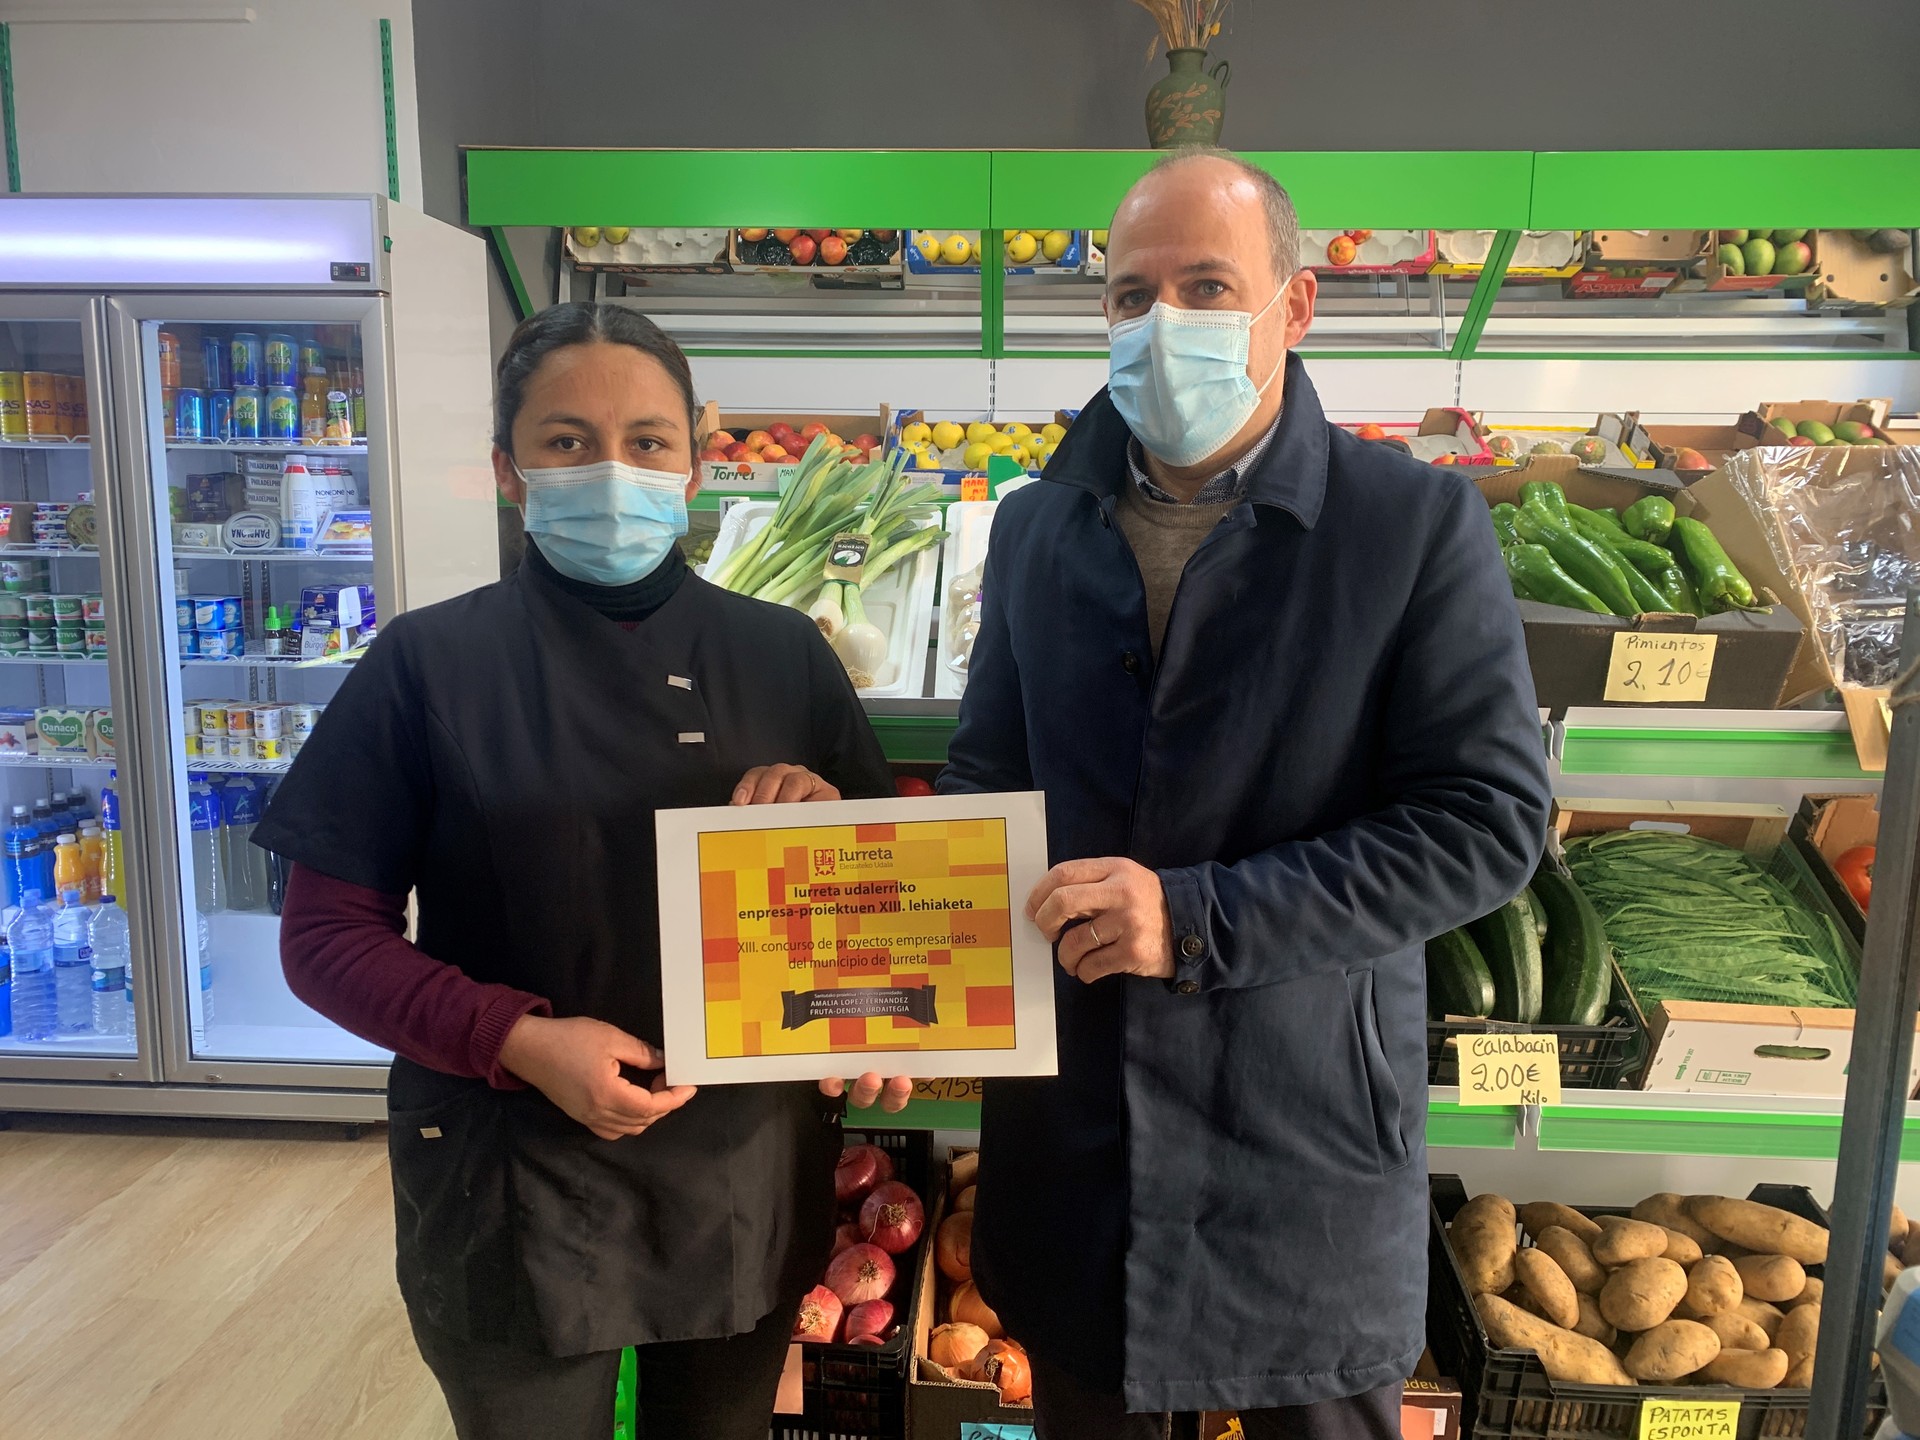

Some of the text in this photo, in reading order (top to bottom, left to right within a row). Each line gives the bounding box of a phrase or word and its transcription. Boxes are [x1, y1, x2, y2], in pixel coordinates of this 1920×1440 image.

[711, 465, 756, 481] Torres
[250, 478, 281, 487] PHILADELPHI
[1624, 635, 1706, 651] Pimientos
[42, 722, 78, 732] Danacol
[838, 847, 894, 862] Iurreta
[794, 881, 916, 898] Iurreta udalerriko
[738, 898, 973, 921] enpresa-proiektuen XIII. lehiaketa
[737, 932, 977, 954] XIII. concurso de proyectos empresariales
[788, 952, 927, 970] del municipio de Iurreta
[810, 999, 839, 1007] AMALIA
[1472, 1035, 1555, 1057] Calabacin
[1649, 1406, 1728, 1424] PATATAS
[1647, 1422, 1731, 1440] ESPONTA
